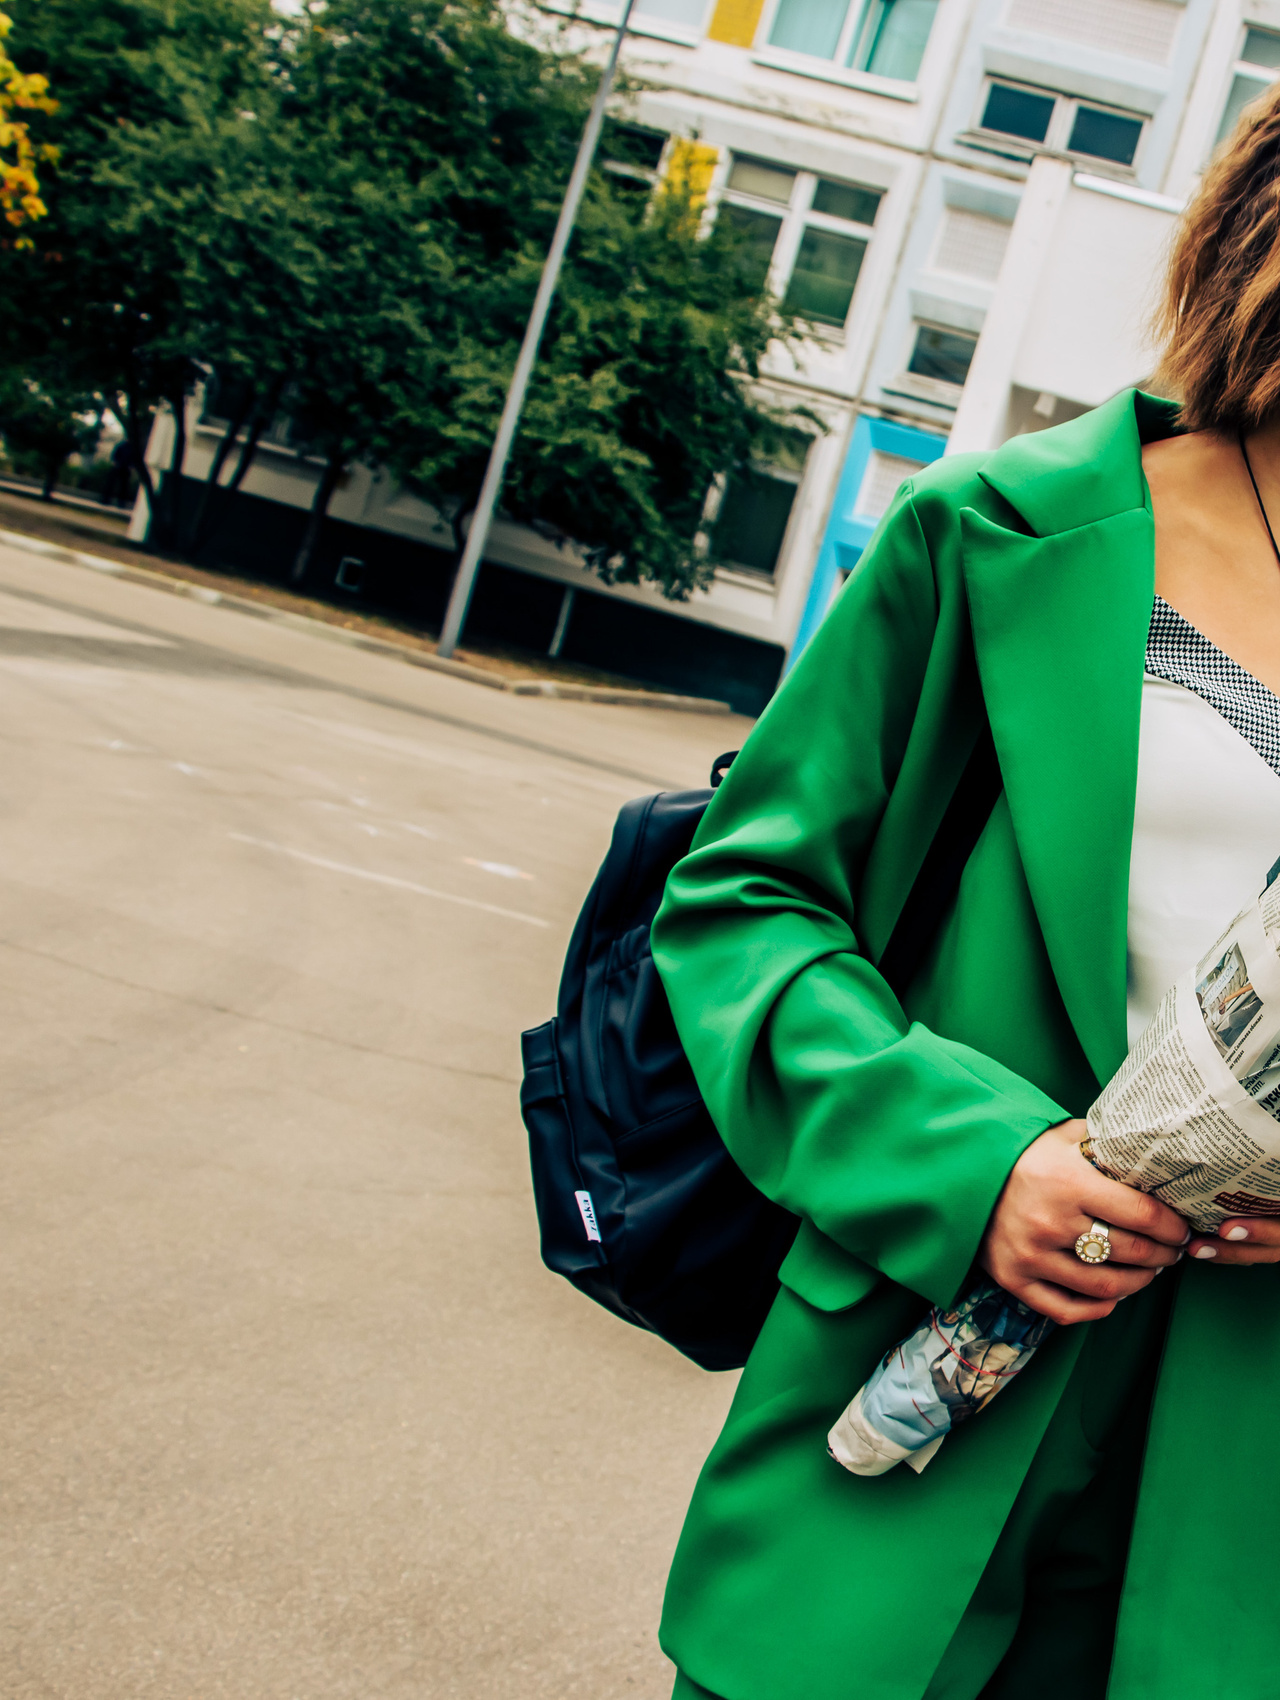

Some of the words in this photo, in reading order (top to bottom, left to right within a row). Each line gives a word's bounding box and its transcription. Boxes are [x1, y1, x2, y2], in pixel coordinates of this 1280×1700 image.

[1249, 1078, 1265, 1094] ДТП.
[1197, 1124, 1206, 1134] 274
[1215, 1116, 1239, 1140] растений.
[1217, 1127, 1225, 1136] 64
[1239, 1131, 1252, 1142] уже
[1221, 1142, 1235, 1155] 1187
